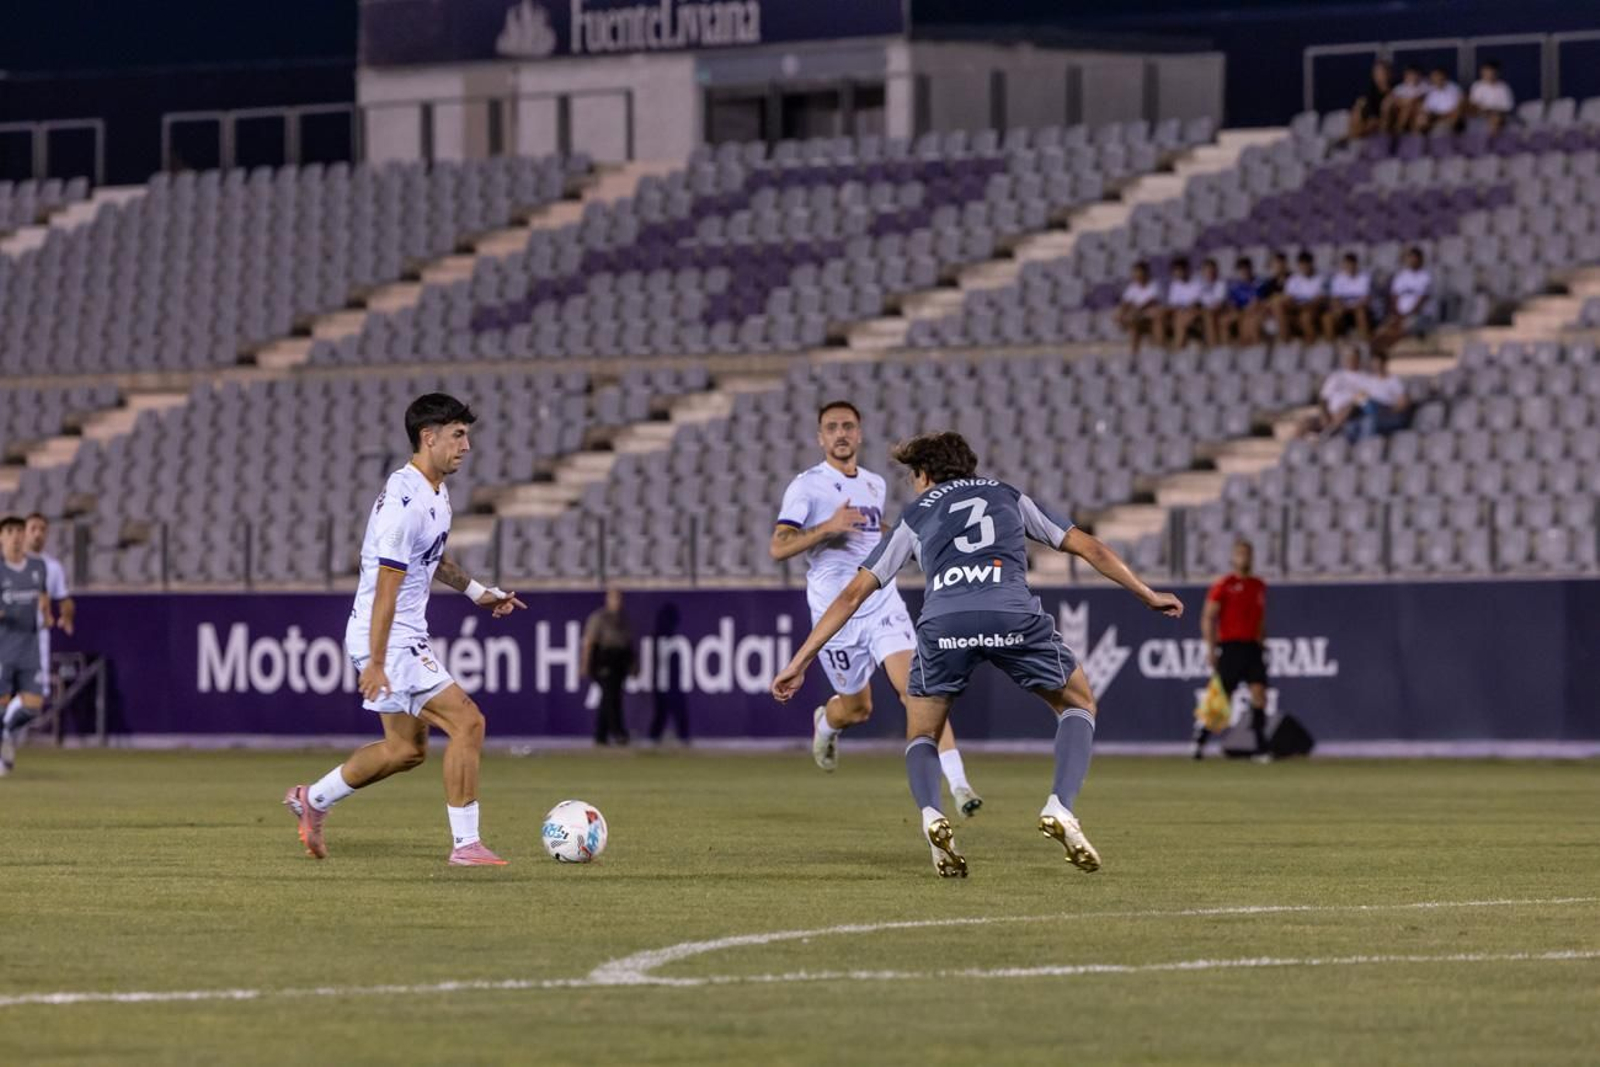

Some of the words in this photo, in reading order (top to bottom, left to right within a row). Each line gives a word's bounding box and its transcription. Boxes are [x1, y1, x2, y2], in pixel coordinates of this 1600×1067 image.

[570, 0, 761, 54] FuenteLiviana
[948, 496, 996, 554] 3
[535, 615, 793, 709] Hundai
[826, 648, 851, 672] 19
[938, 632, 1024, 650] micolchón
[1217, 637, 1339, 677] RAL
